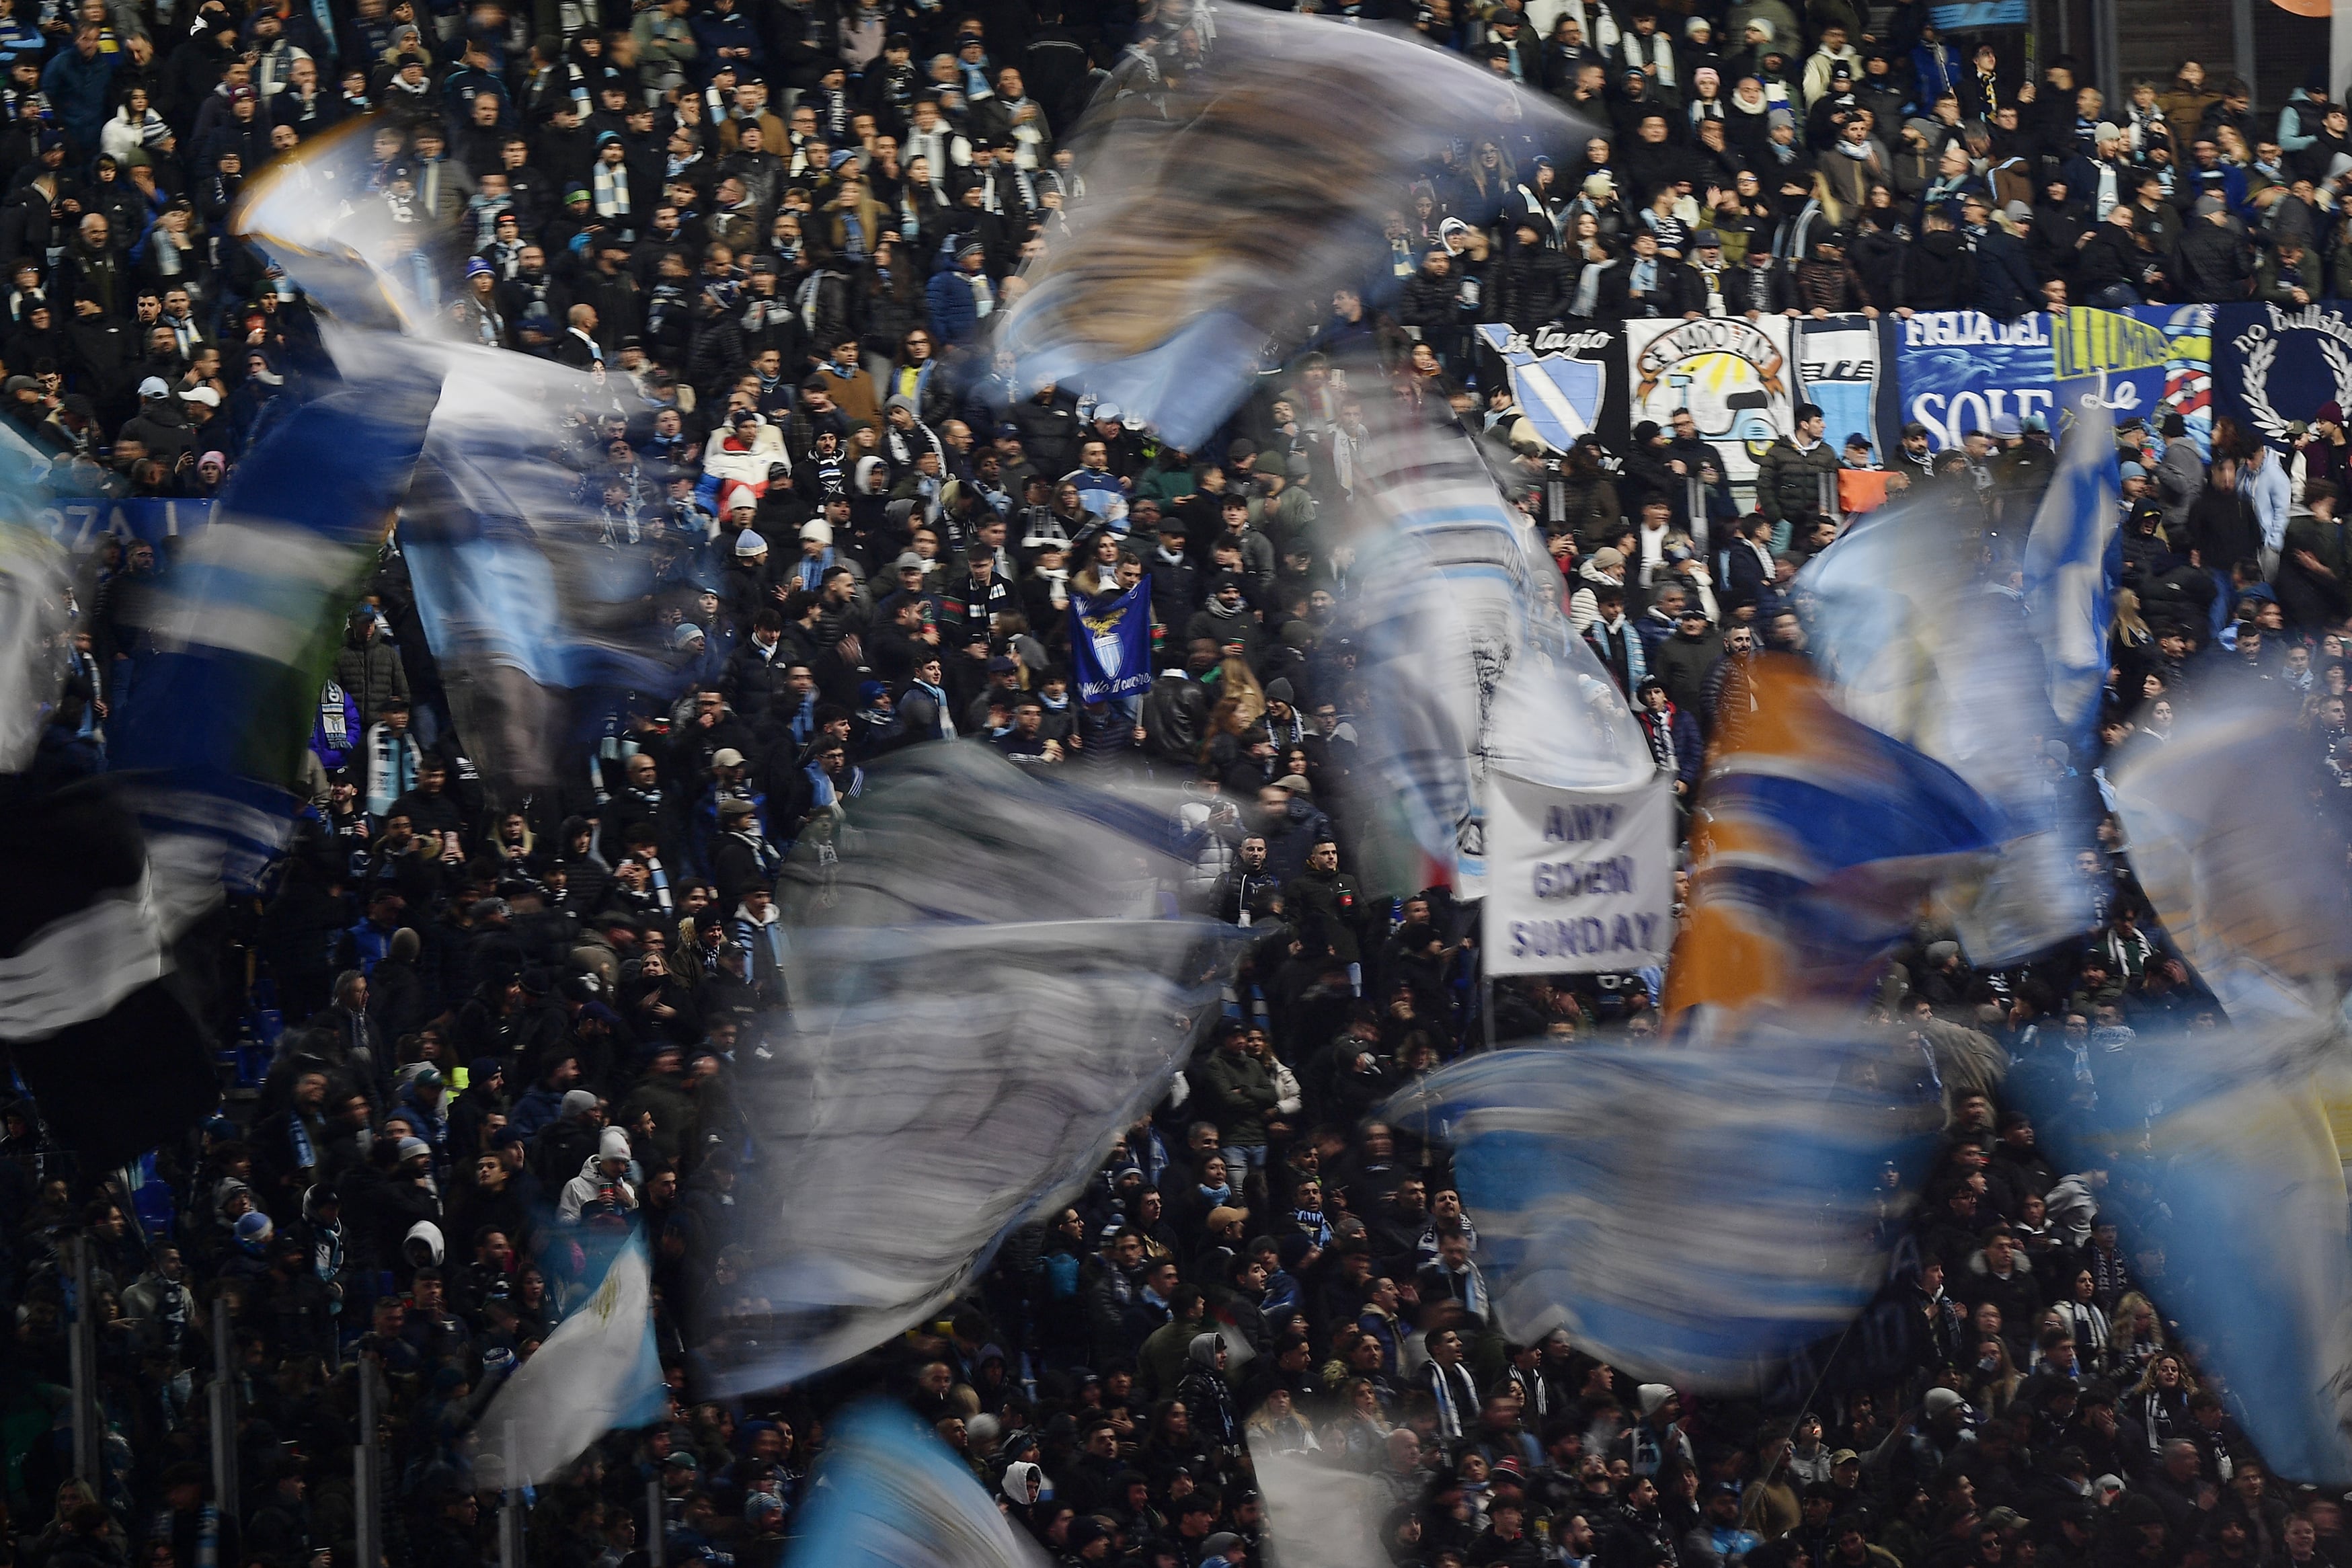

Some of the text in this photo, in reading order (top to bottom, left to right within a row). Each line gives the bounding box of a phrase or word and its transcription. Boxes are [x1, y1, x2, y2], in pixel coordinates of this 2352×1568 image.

[2232, 324, 2268, 354] no
[1543, 803, 1622, 842] ANY
[1510, 912, 1662, 957] SUNDAY
